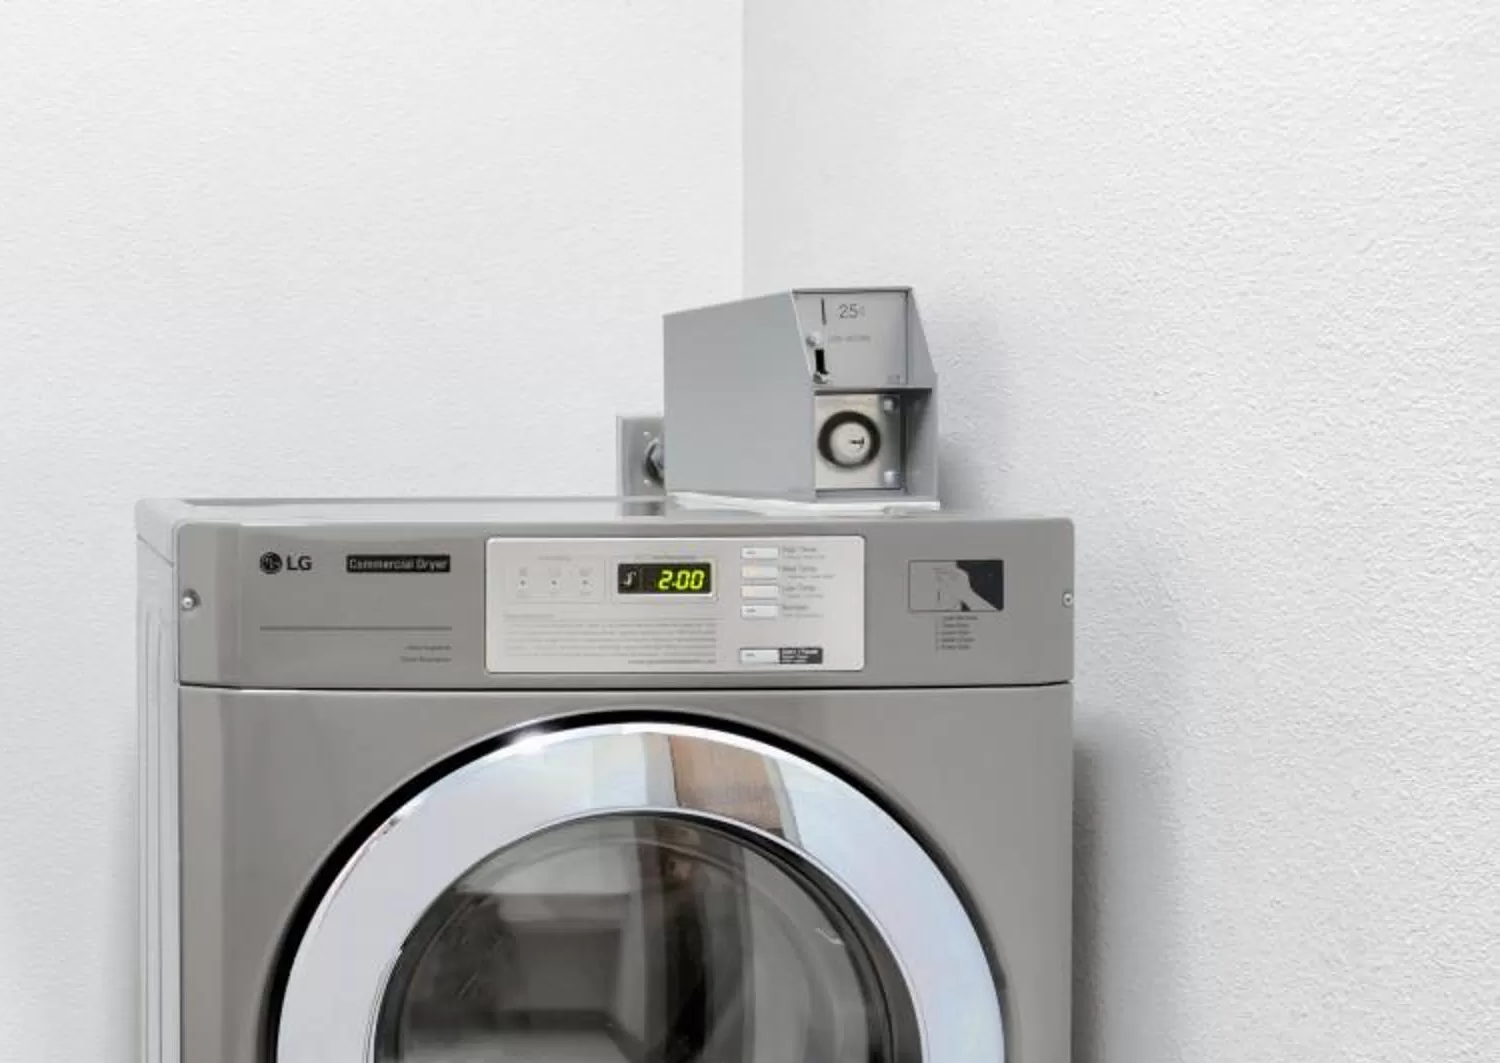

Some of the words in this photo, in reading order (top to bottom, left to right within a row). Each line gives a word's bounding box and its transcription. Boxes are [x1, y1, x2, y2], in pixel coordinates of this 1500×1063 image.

[286, 555, 313, 571] LG
[349, 558, 414, 571] Commercial
[416, 558, 448, 572] Dryer
